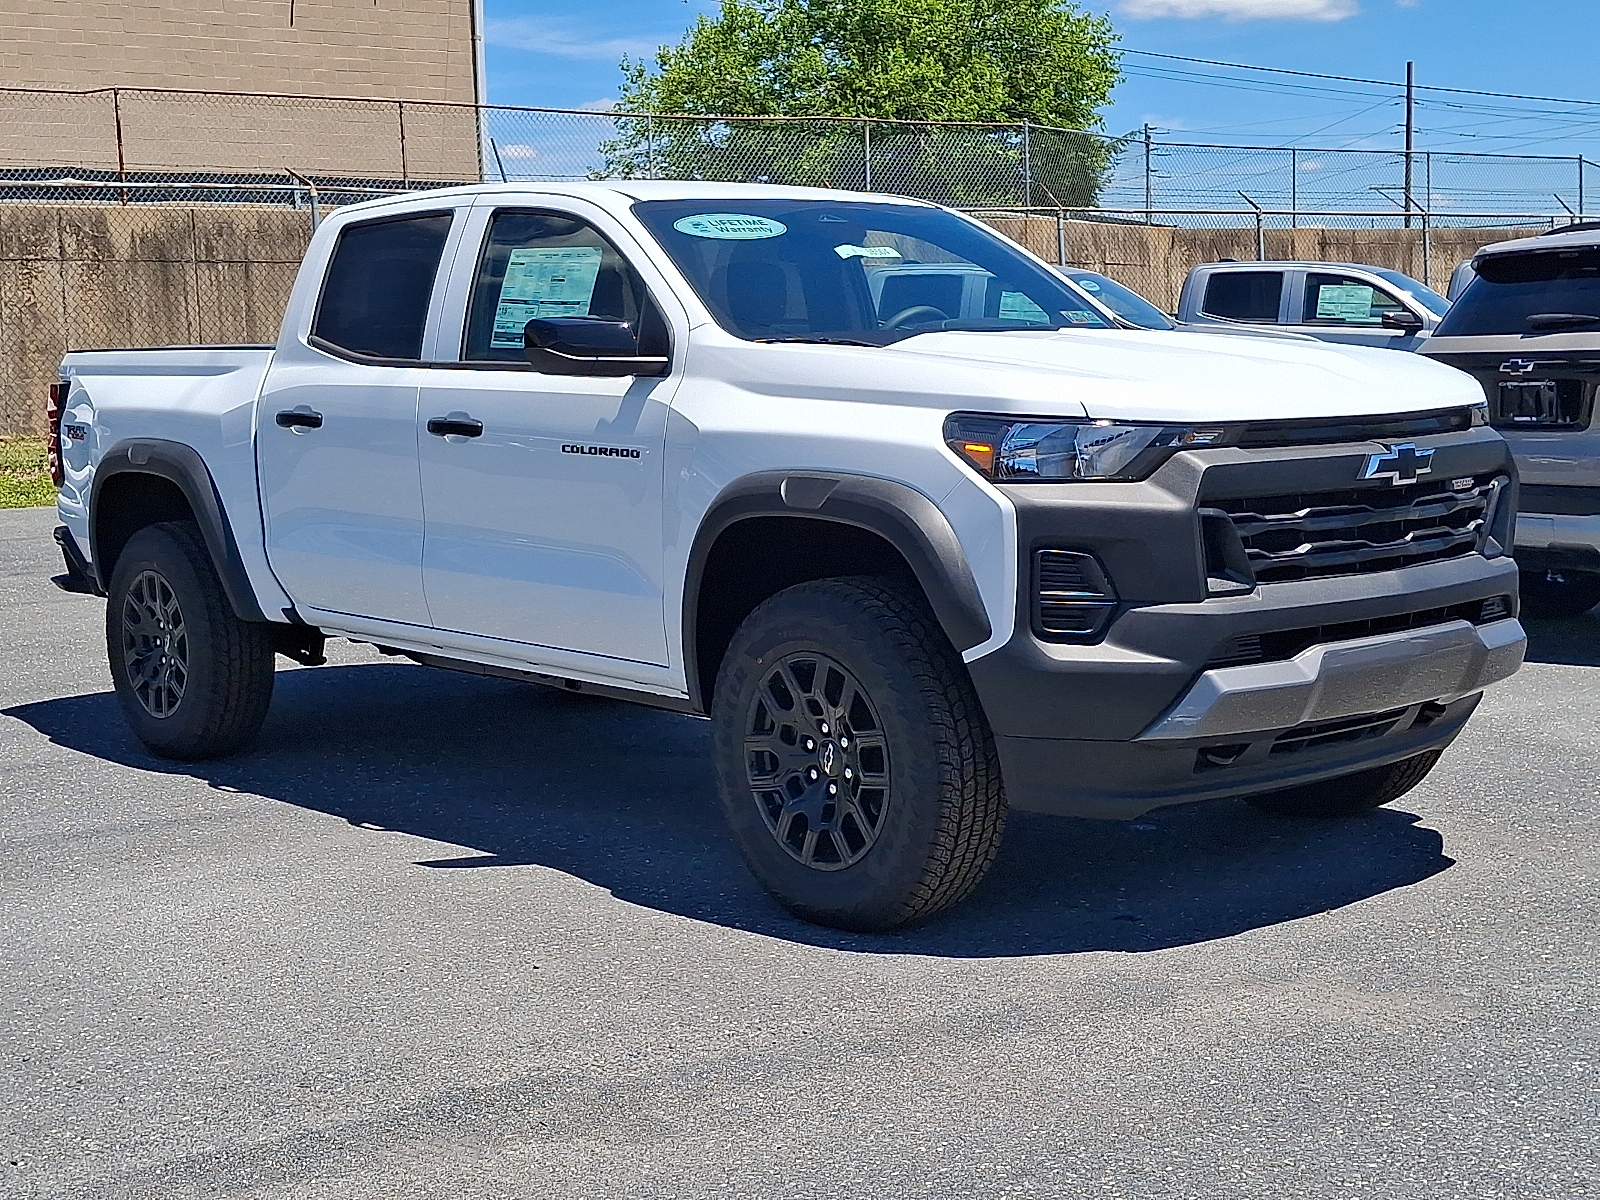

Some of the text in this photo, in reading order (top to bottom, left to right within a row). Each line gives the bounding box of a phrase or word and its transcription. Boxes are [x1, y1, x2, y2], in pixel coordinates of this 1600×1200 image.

[708, 219, 769, 227] LIFETIME
[715, 226, 774, 234] Warranty
[561, 444, 641, 459] COLORADO
